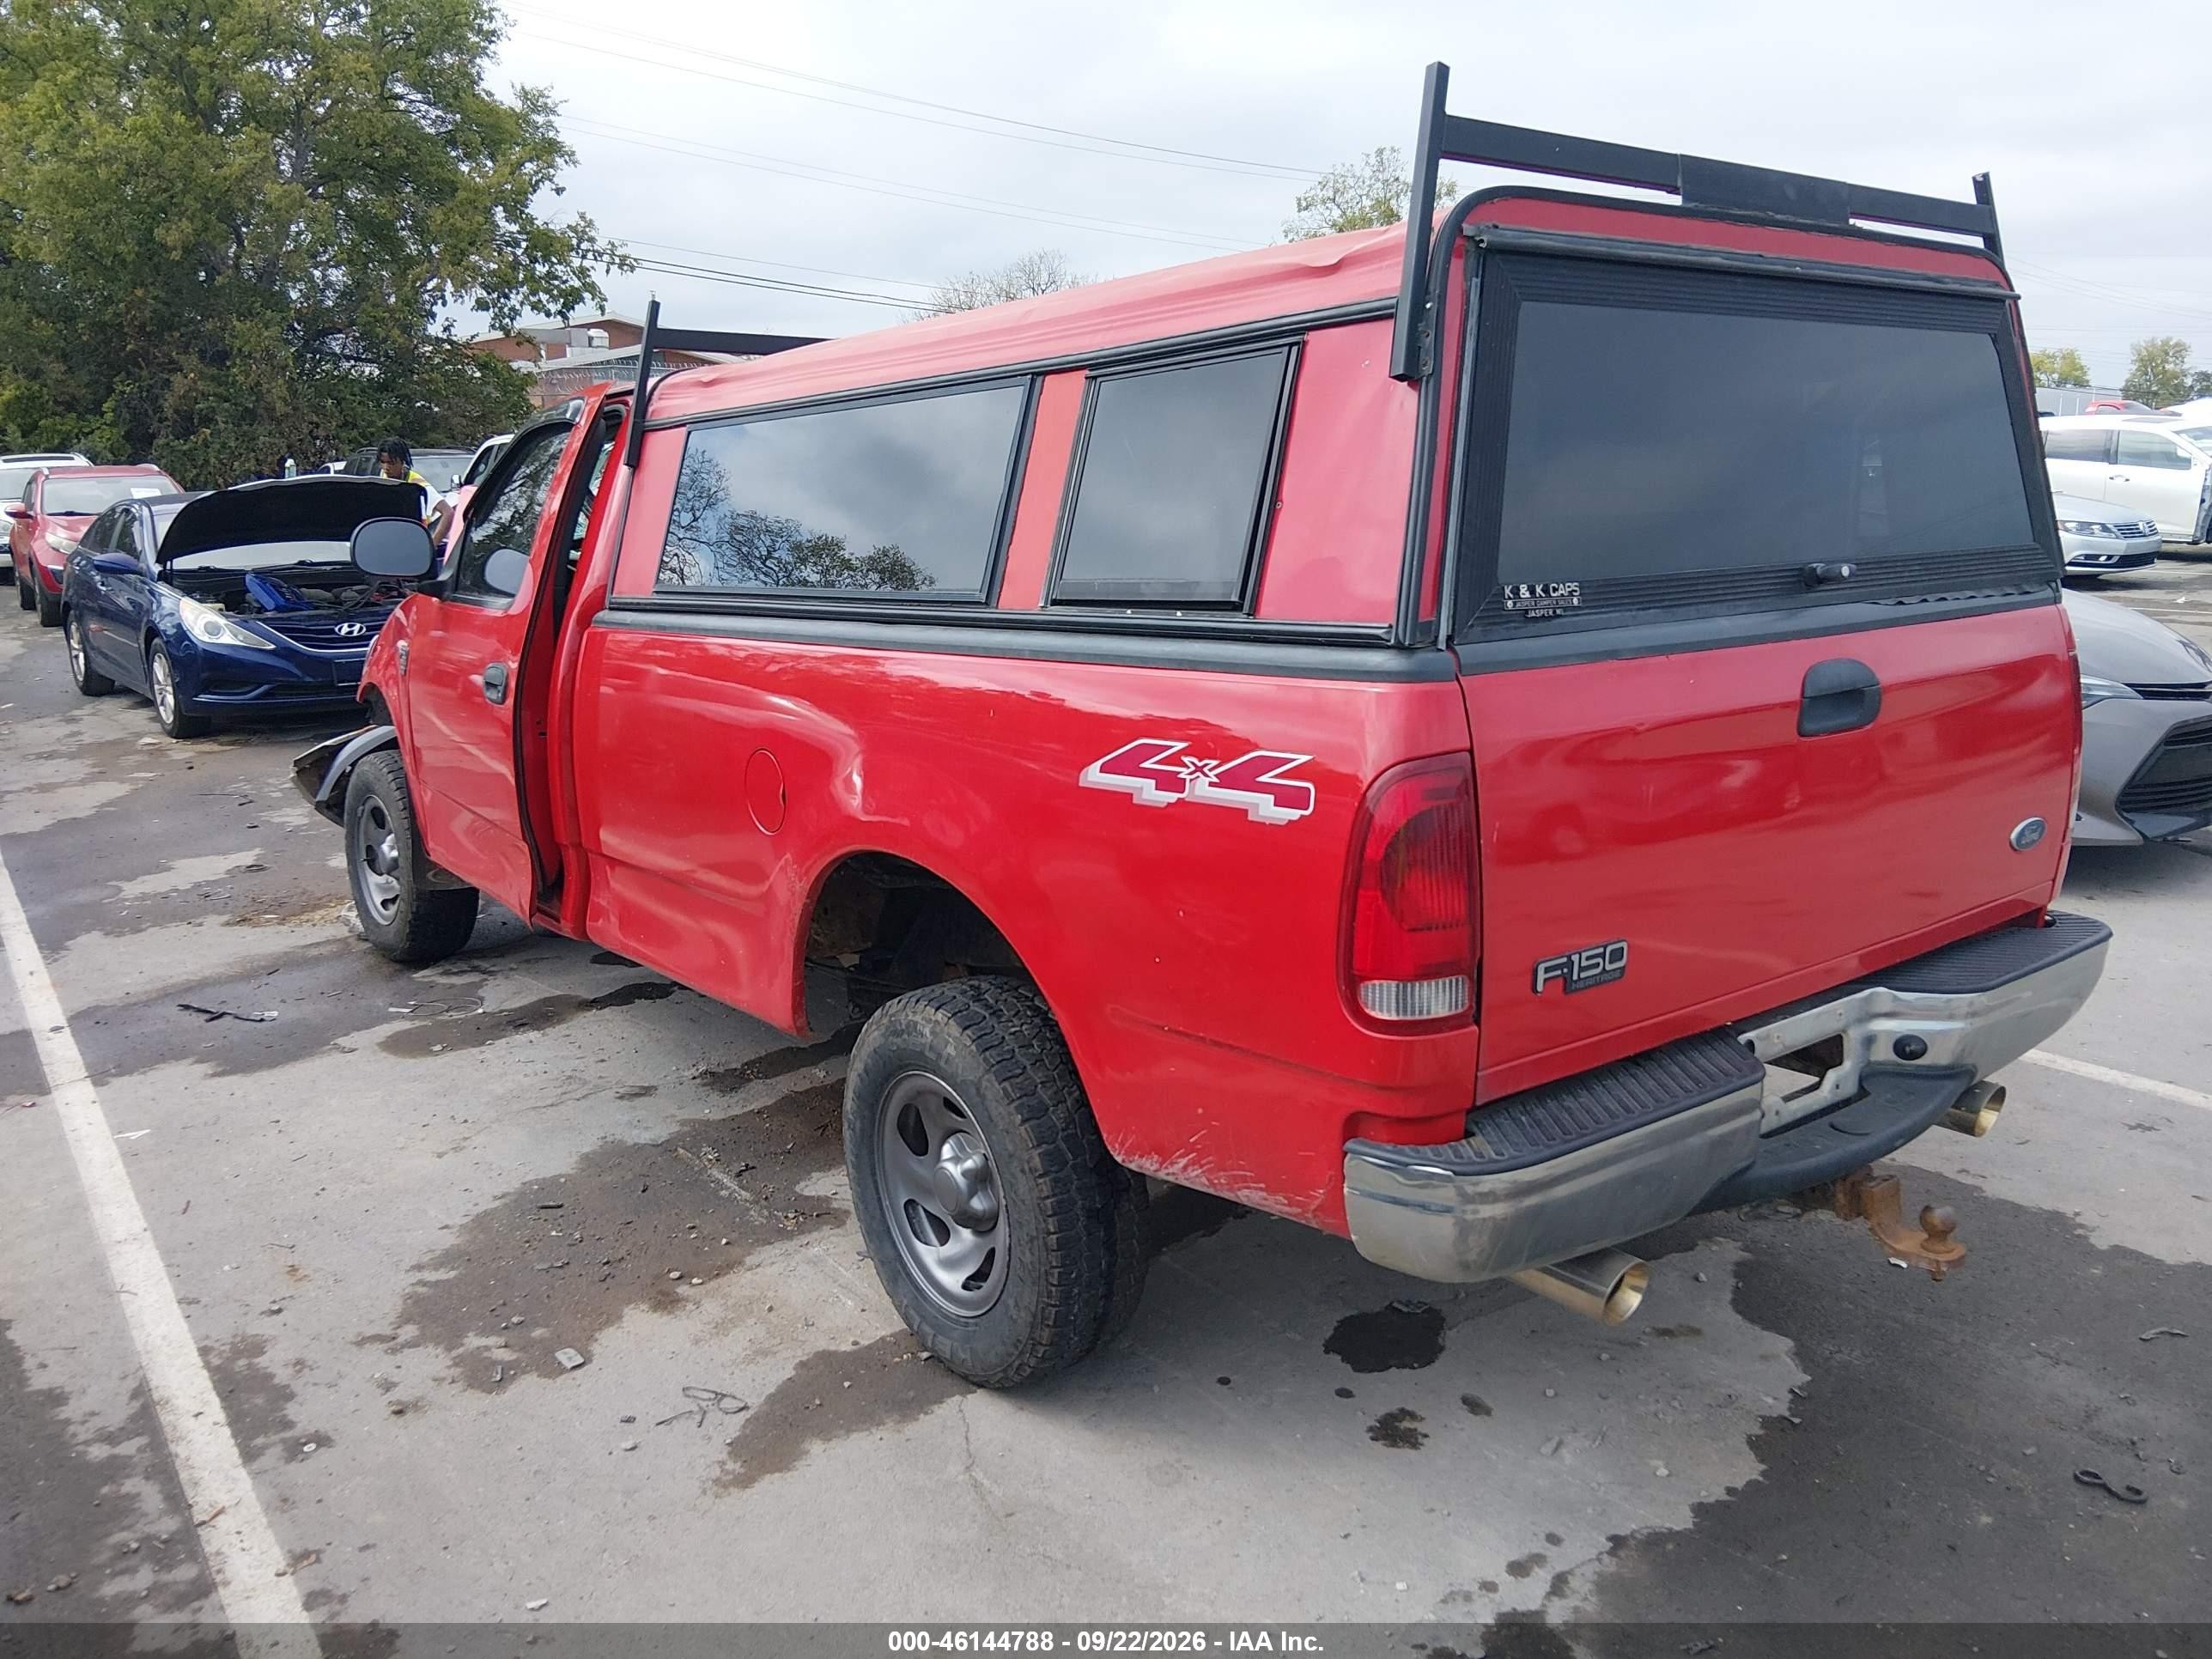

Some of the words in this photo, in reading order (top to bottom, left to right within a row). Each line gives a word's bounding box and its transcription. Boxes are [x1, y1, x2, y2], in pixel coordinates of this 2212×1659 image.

[1504, 585, 1514, 599] K
[1519, 584, 1531, 599] &
[1535, 583, 1546, 598] K
[1549, 582, 1580, 597] CAPS
[1525, 609, 1553, 618] JASPER
[1536, 940, 1628, 993] F-150
